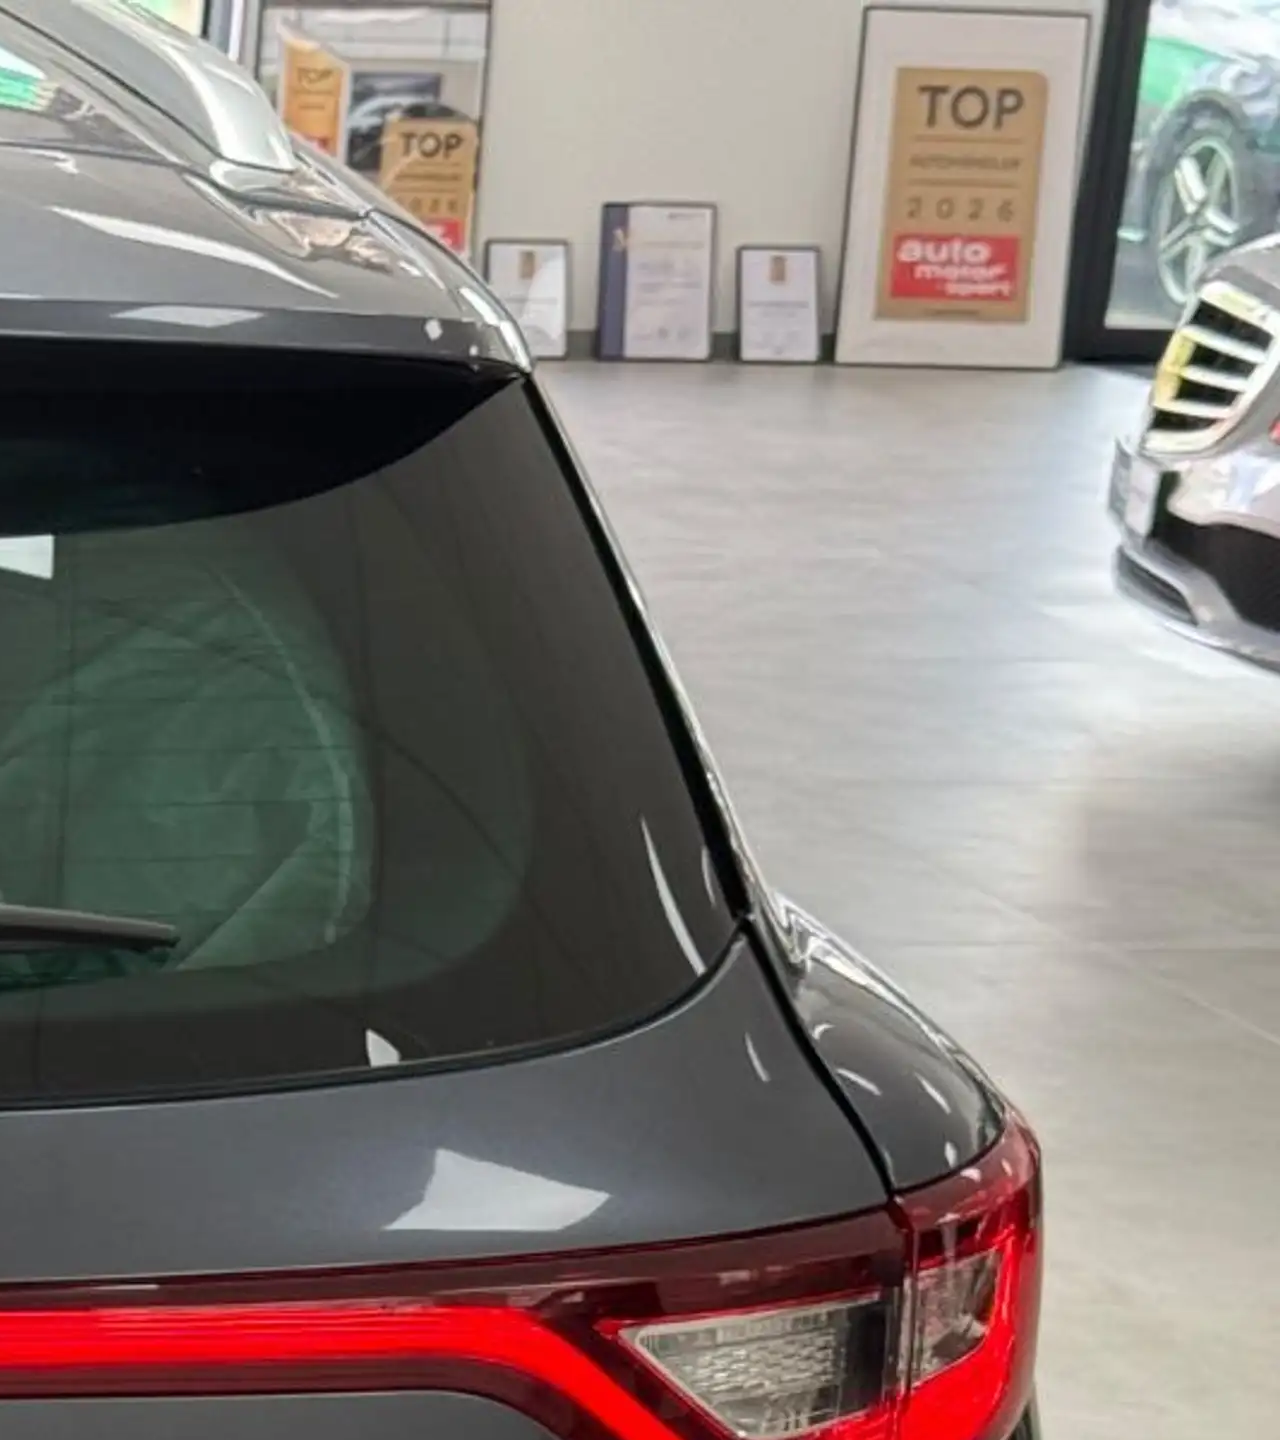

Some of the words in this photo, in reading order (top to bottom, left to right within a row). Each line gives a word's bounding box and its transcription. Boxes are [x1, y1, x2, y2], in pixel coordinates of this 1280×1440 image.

[916, 84, 1025, 130] TOP
[399, 131, 465, 159] TOP
[906, 196, 1015, 222] 2026
[895, 236, 992, 264] auto
